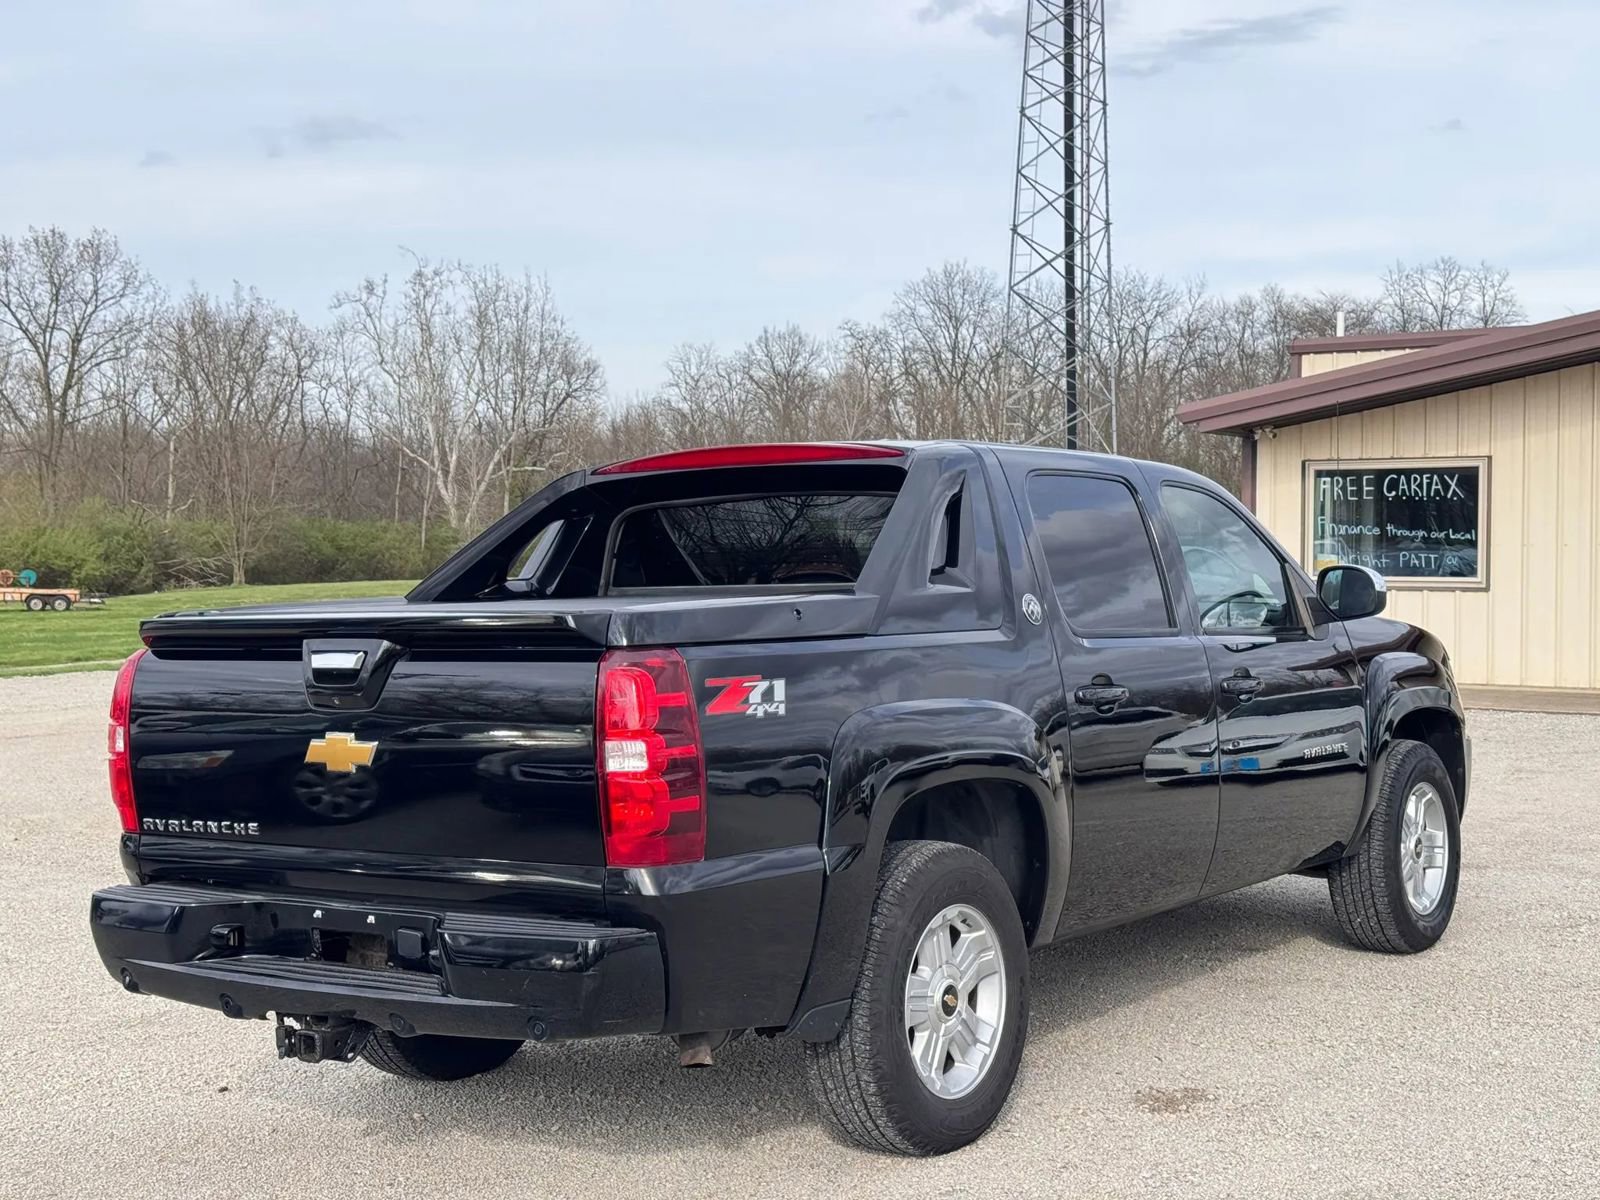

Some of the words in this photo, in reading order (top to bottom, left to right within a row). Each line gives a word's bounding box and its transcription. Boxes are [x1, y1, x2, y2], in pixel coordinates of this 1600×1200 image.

[1319, 475, 1375, 501] FREE
[1383, 473, 1465, 500] CARFAX
[1385, 522, 1428, 542] through
[1430, 531, 1448, 539] our
[1399, 551, 1438, 569] PATT
[704, 675, 786, 716] Z71
[142, 817, 260, 835] AVALANCHE
